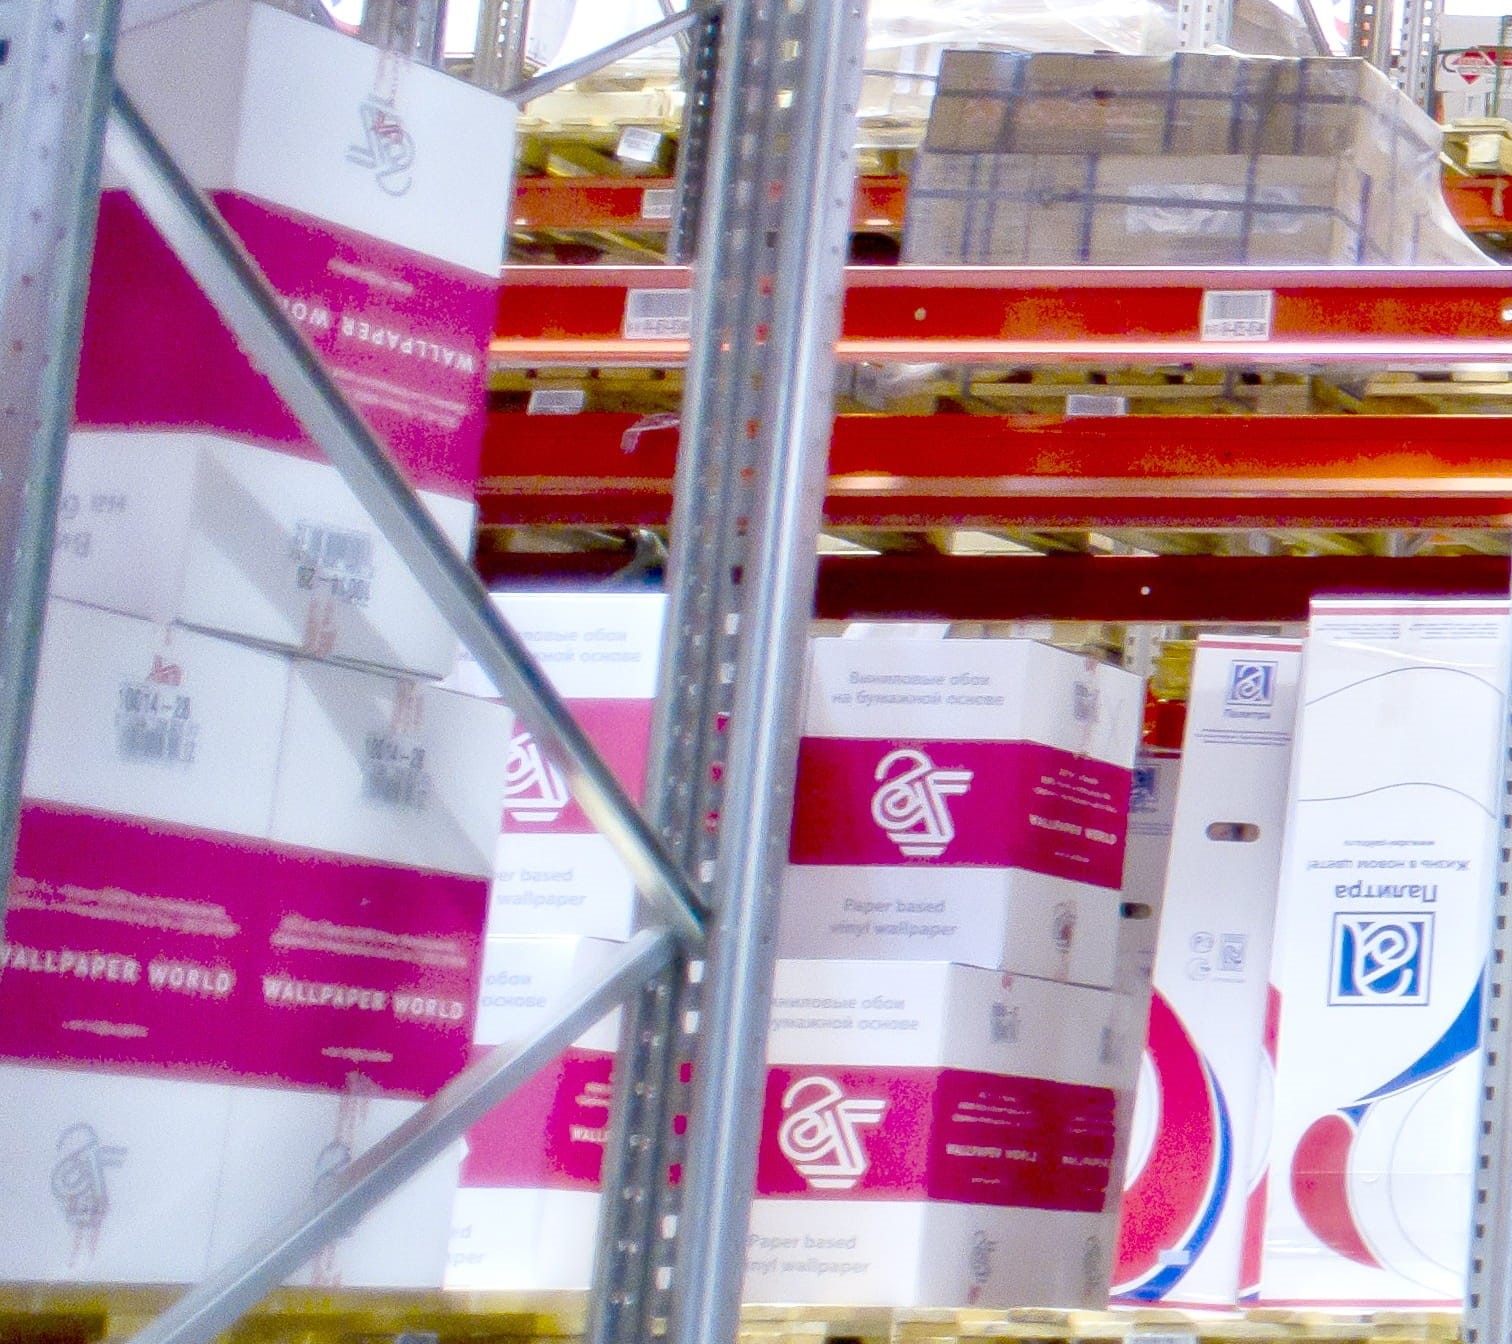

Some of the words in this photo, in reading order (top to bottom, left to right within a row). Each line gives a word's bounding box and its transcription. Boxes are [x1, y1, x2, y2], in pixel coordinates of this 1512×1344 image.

[341, 314, 475, 374] WALLPAPER
[949, 671, 991, 686] обои
[1334, 878, 1438, 904] Палитра
[895, 899, 947, 914] based
[146, 957, 237, 998] WORLD
[262, 977, 388, 1014] WALLPAPER
[392, 990, 468, 1024] WORLD
[861, 994, 906, 1010] обои
